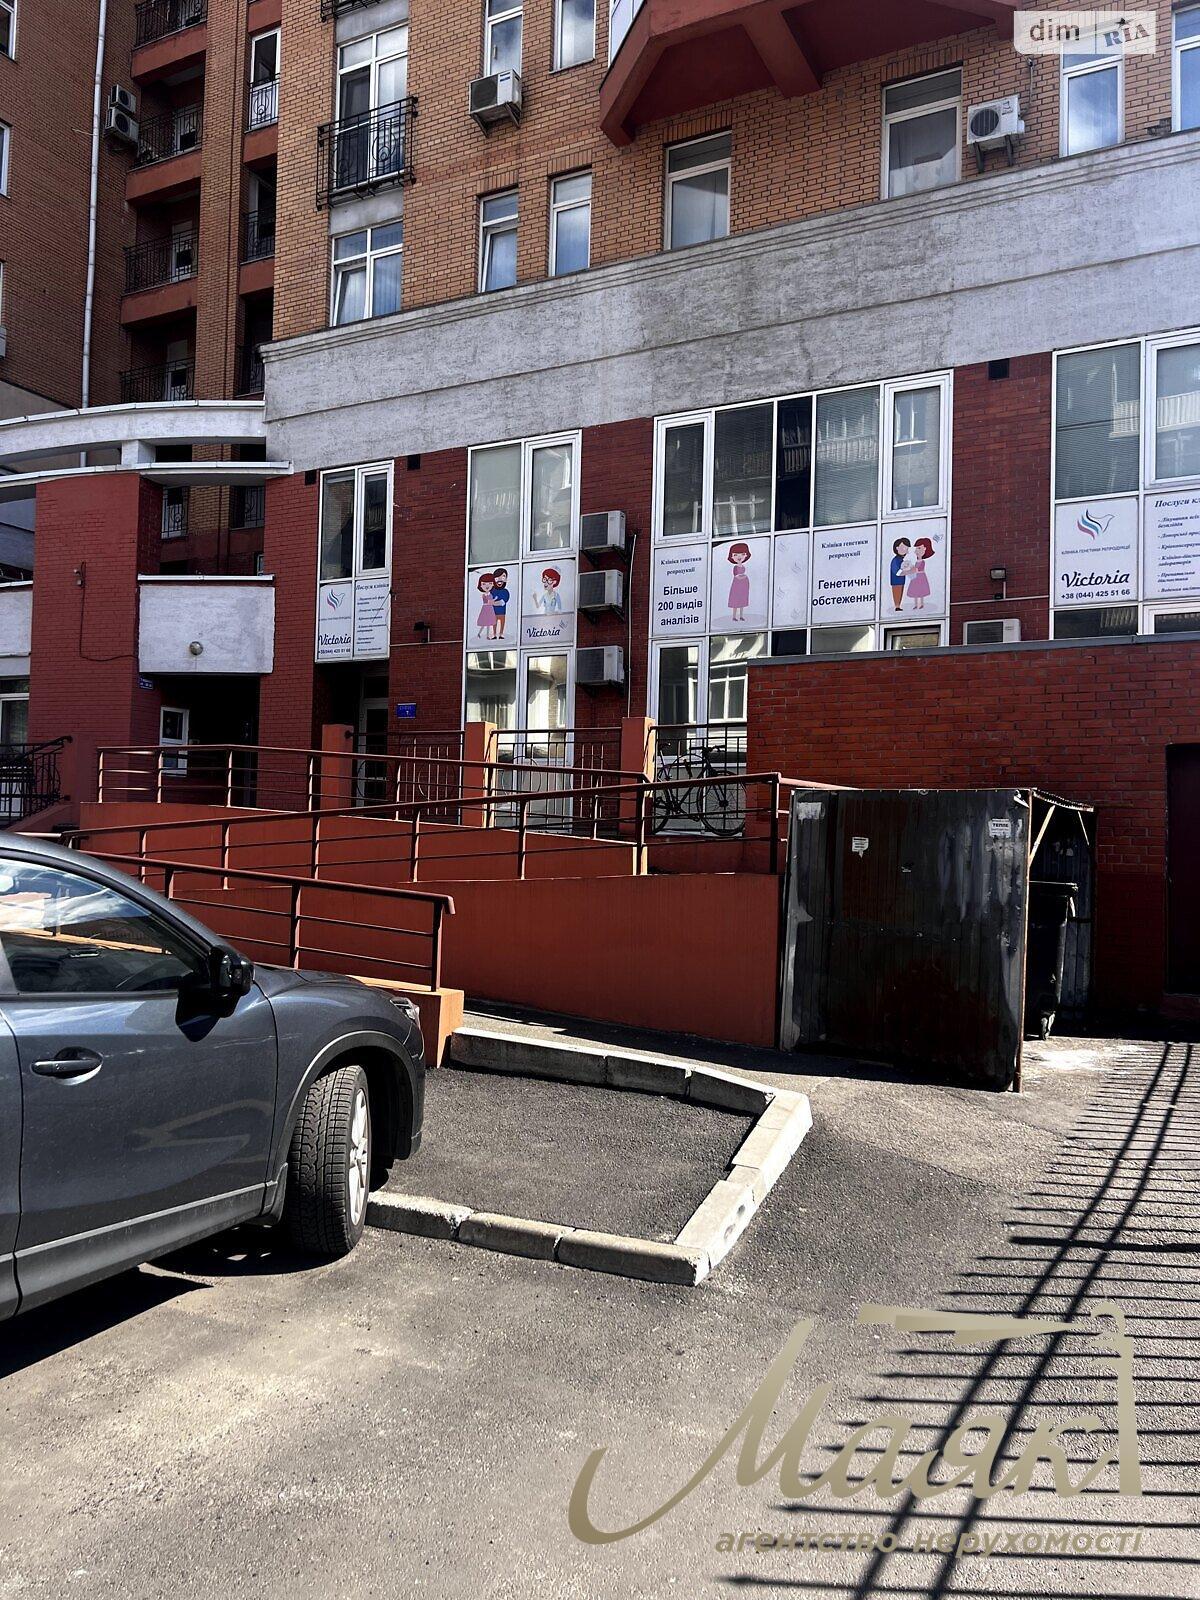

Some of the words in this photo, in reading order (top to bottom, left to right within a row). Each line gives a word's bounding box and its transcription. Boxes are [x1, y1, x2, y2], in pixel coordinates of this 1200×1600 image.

[1154, 498, 1190, 508] Послуги
[821, 540, 842, 549] Клініка
[843, 539, 869, 547] генетики
[660, 558, 679, 566] Клініка
[680, 556, 702, 564] генетики
[828, 550, 861, 560] репродукції
[818, 575, 870, 590] Генетичні
[1061, 569, 1130, 588] Victoria
[663, 584, 698, 596] Більше
[1061, 592, 1074, 600] +38
[1075, 591, 1094, 600] (044)
[1121, 588, 1131, 596] 66
[657, 601, 674, 611] 200
[676, 598, 703, 610] видів
[812, 593, 876, 606] обстеження
[660, 614, 700, 626] аналізів
[527, 626, 560, 638] Victoria
[319, 633, 351, 646] Victoria
